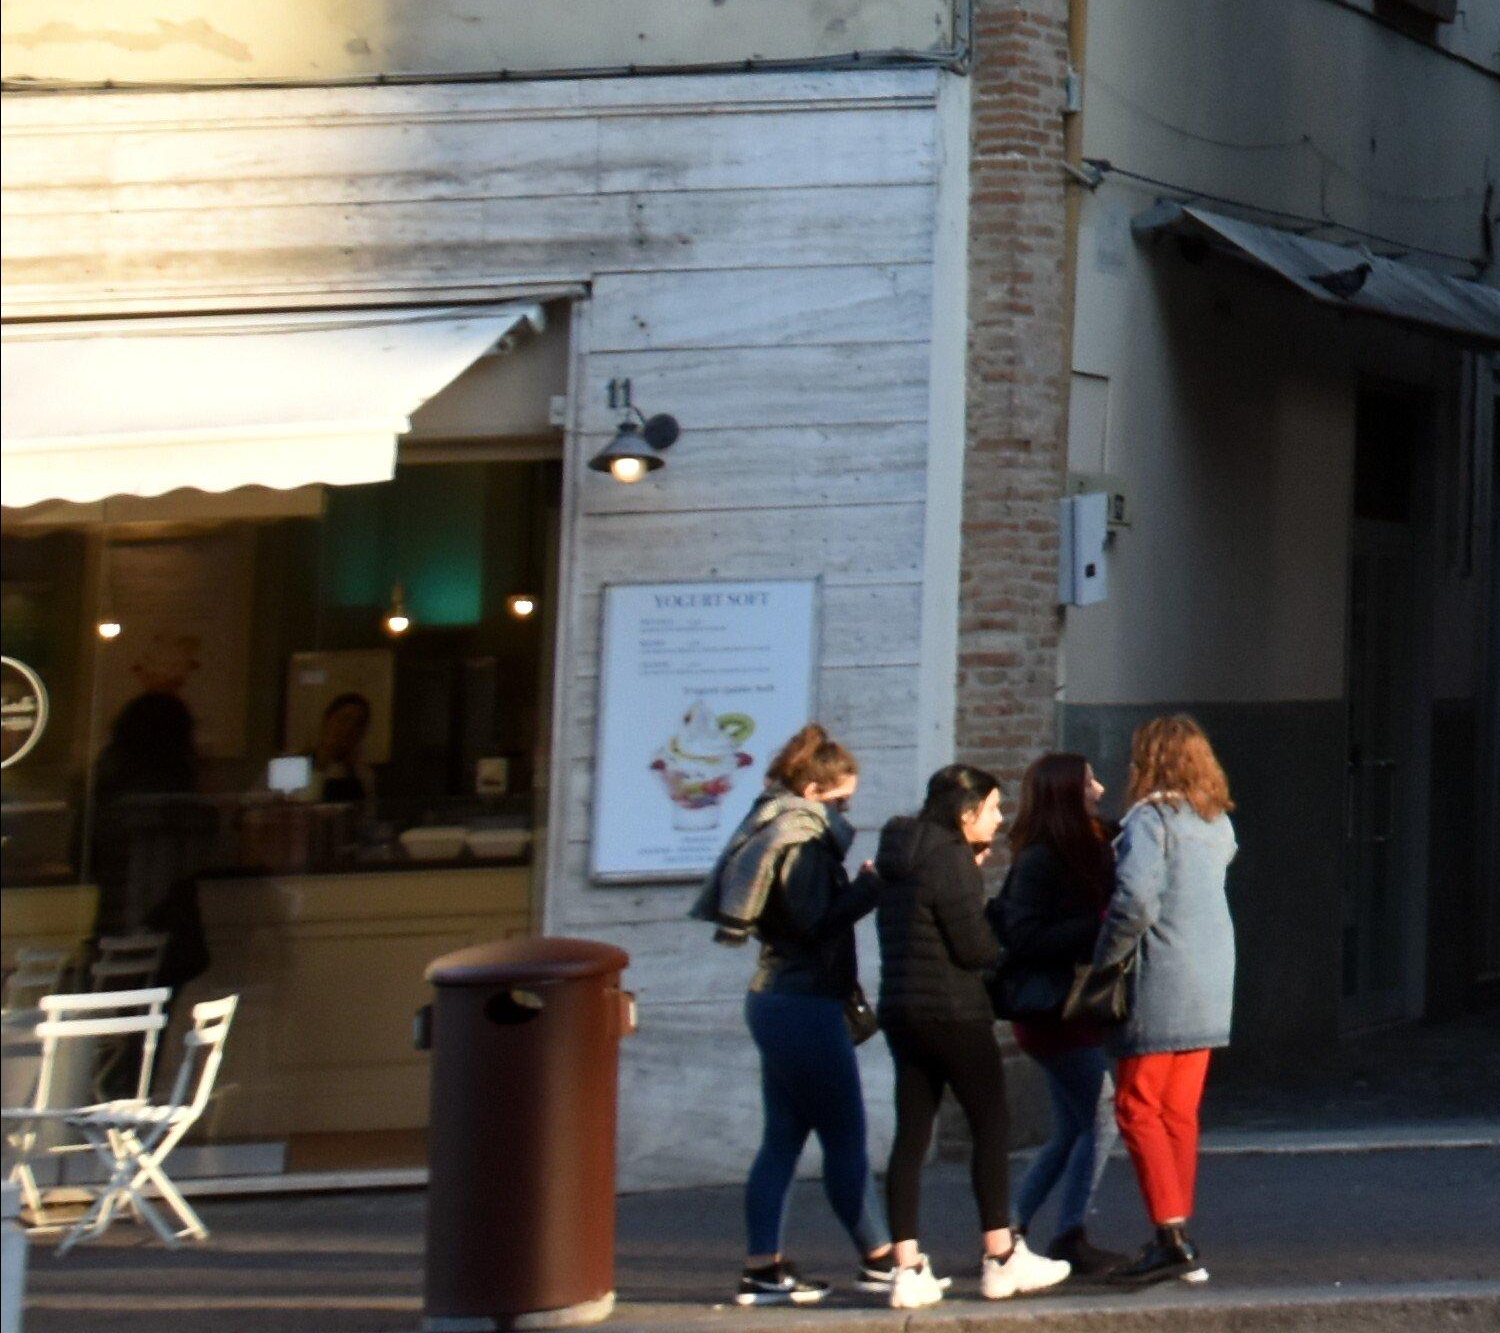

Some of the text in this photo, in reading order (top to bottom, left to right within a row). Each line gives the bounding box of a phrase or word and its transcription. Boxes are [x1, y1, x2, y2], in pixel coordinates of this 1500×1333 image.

[608, 378, 631, 409] 11
[655, 591, 770, 608] YOGURT SOFT
